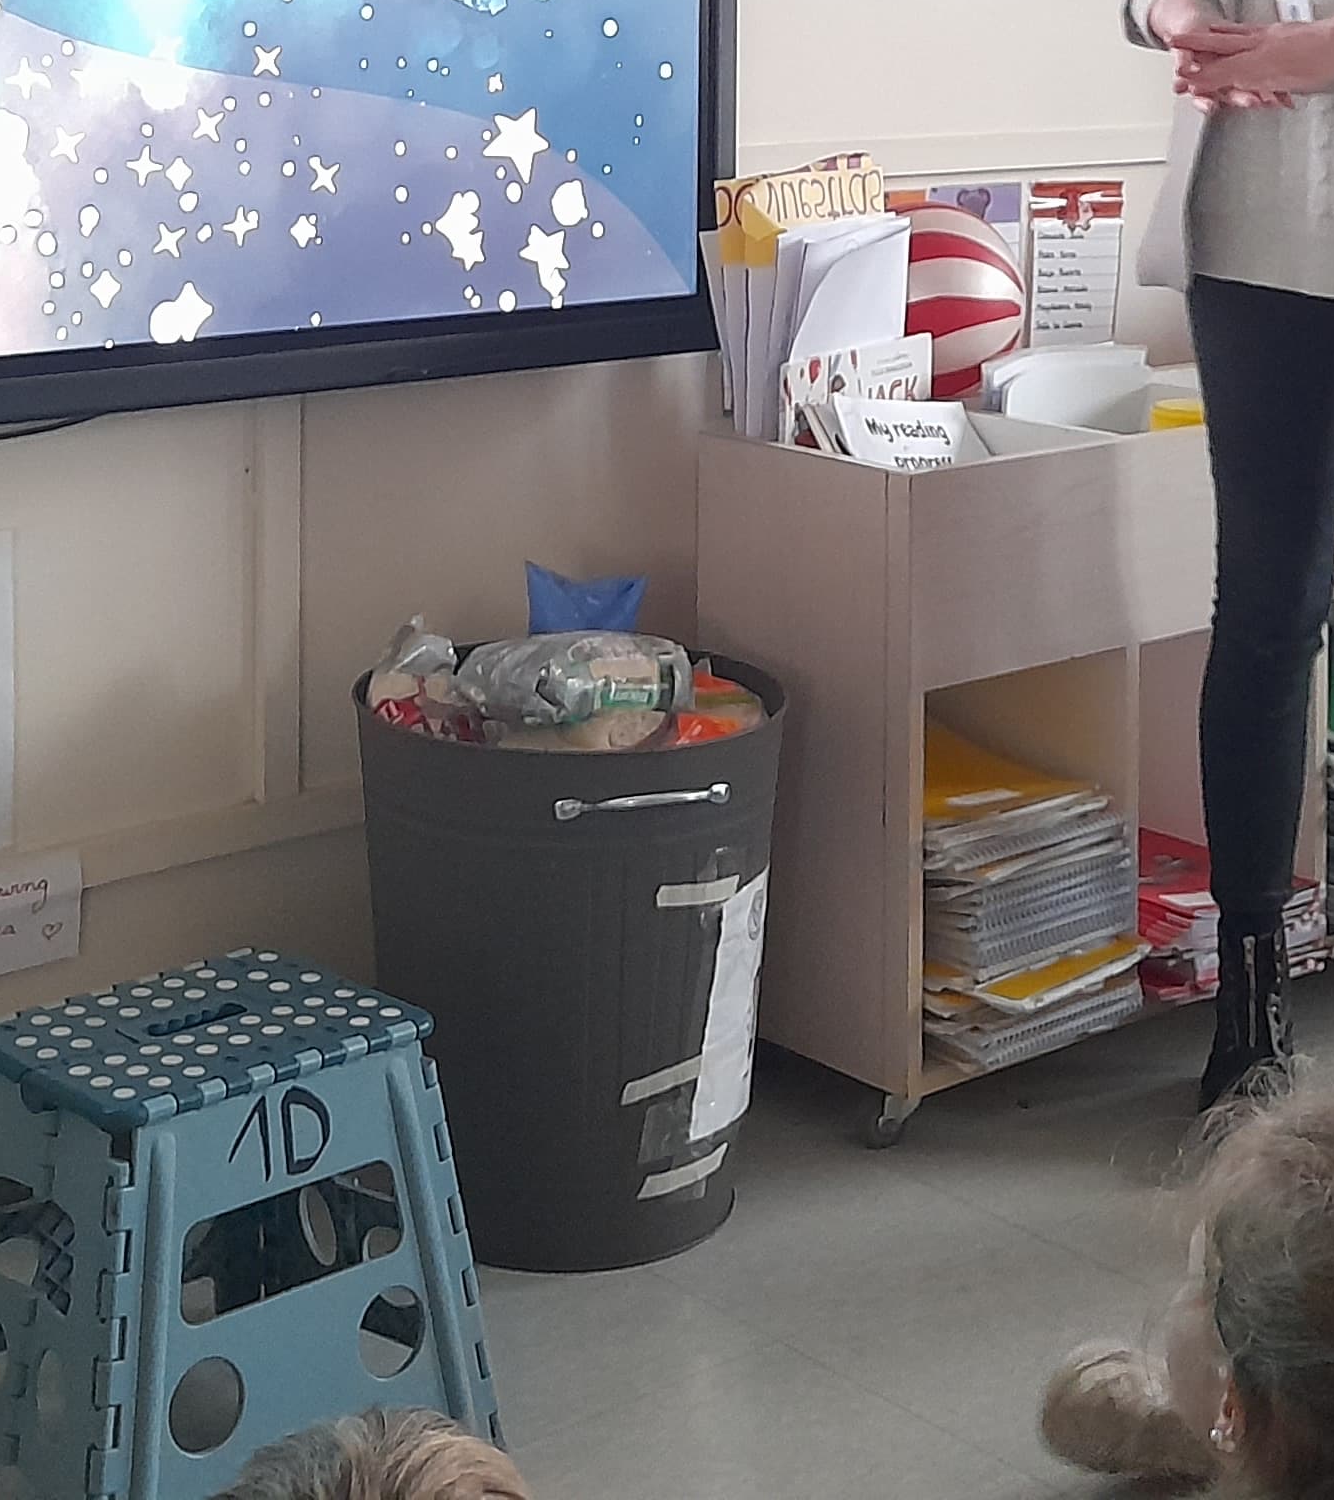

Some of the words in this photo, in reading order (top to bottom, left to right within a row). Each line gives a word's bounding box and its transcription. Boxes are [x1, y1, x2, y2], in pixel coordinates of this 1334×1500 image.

[865, 417, 894, 443] My
[893, 419, 951, 446] reading
[228, 1084, 331, 1182] 1D
